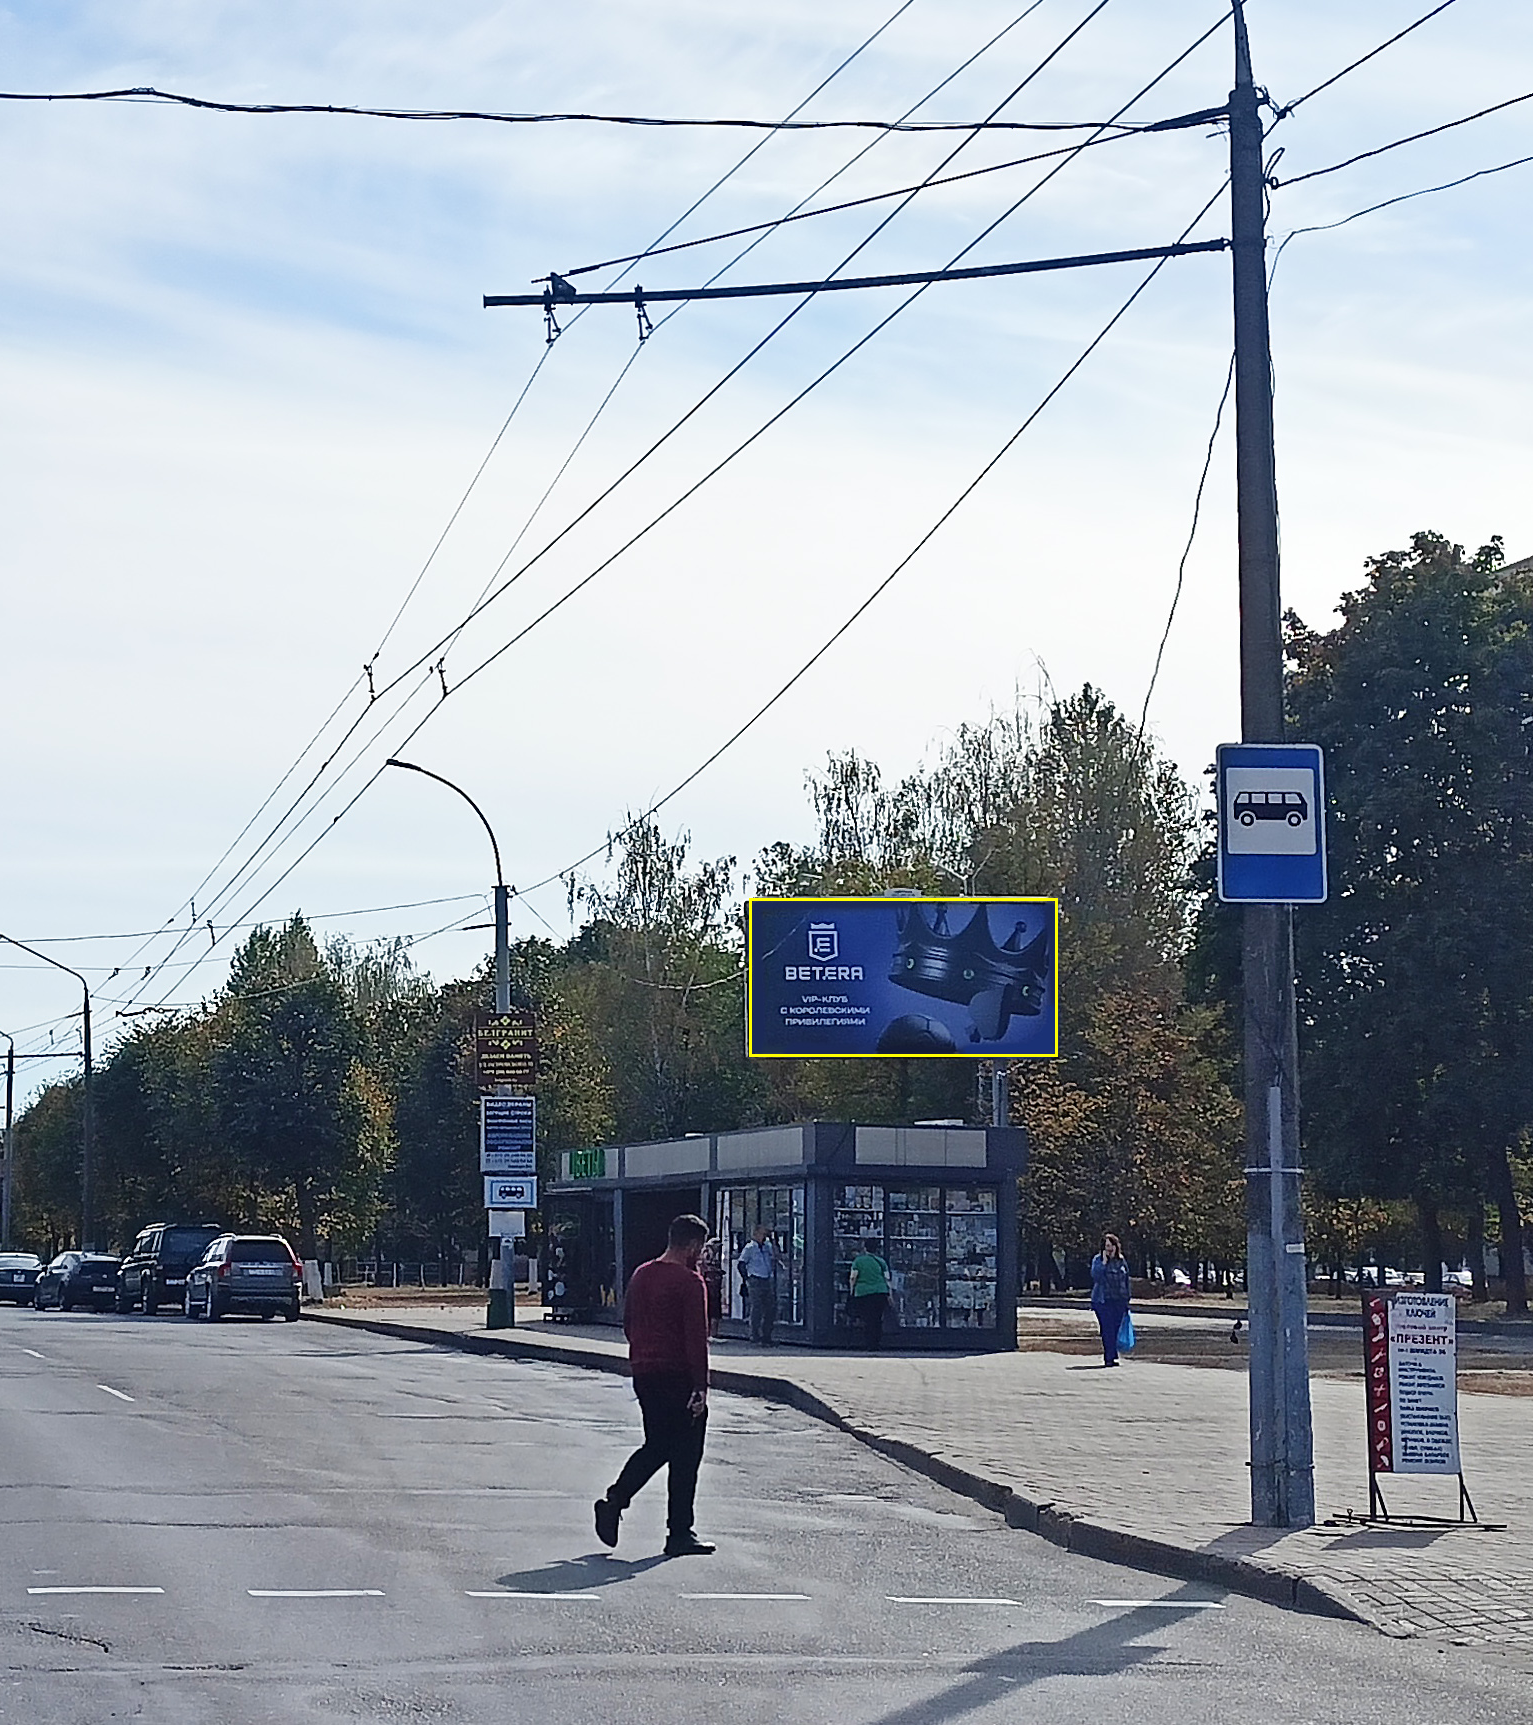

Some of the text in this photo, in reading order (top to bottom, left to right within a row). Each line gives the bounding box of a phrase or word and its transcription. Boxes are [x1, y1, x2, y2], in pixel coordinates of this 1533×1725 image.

[801, 995, 849, 1003] VIP-КЛУБ
[780, 1006, 871, 1015] С КОРОЛЕВСКИМИ
[785, 1018, 866, 1026] ПРИВИЛЕГИЯМИ
[1405, 1308, 1437, 1319] КЛЮЧЕЙ
[1390, 1333, 1454, 1346] «ПРЕЗЕНТ»
